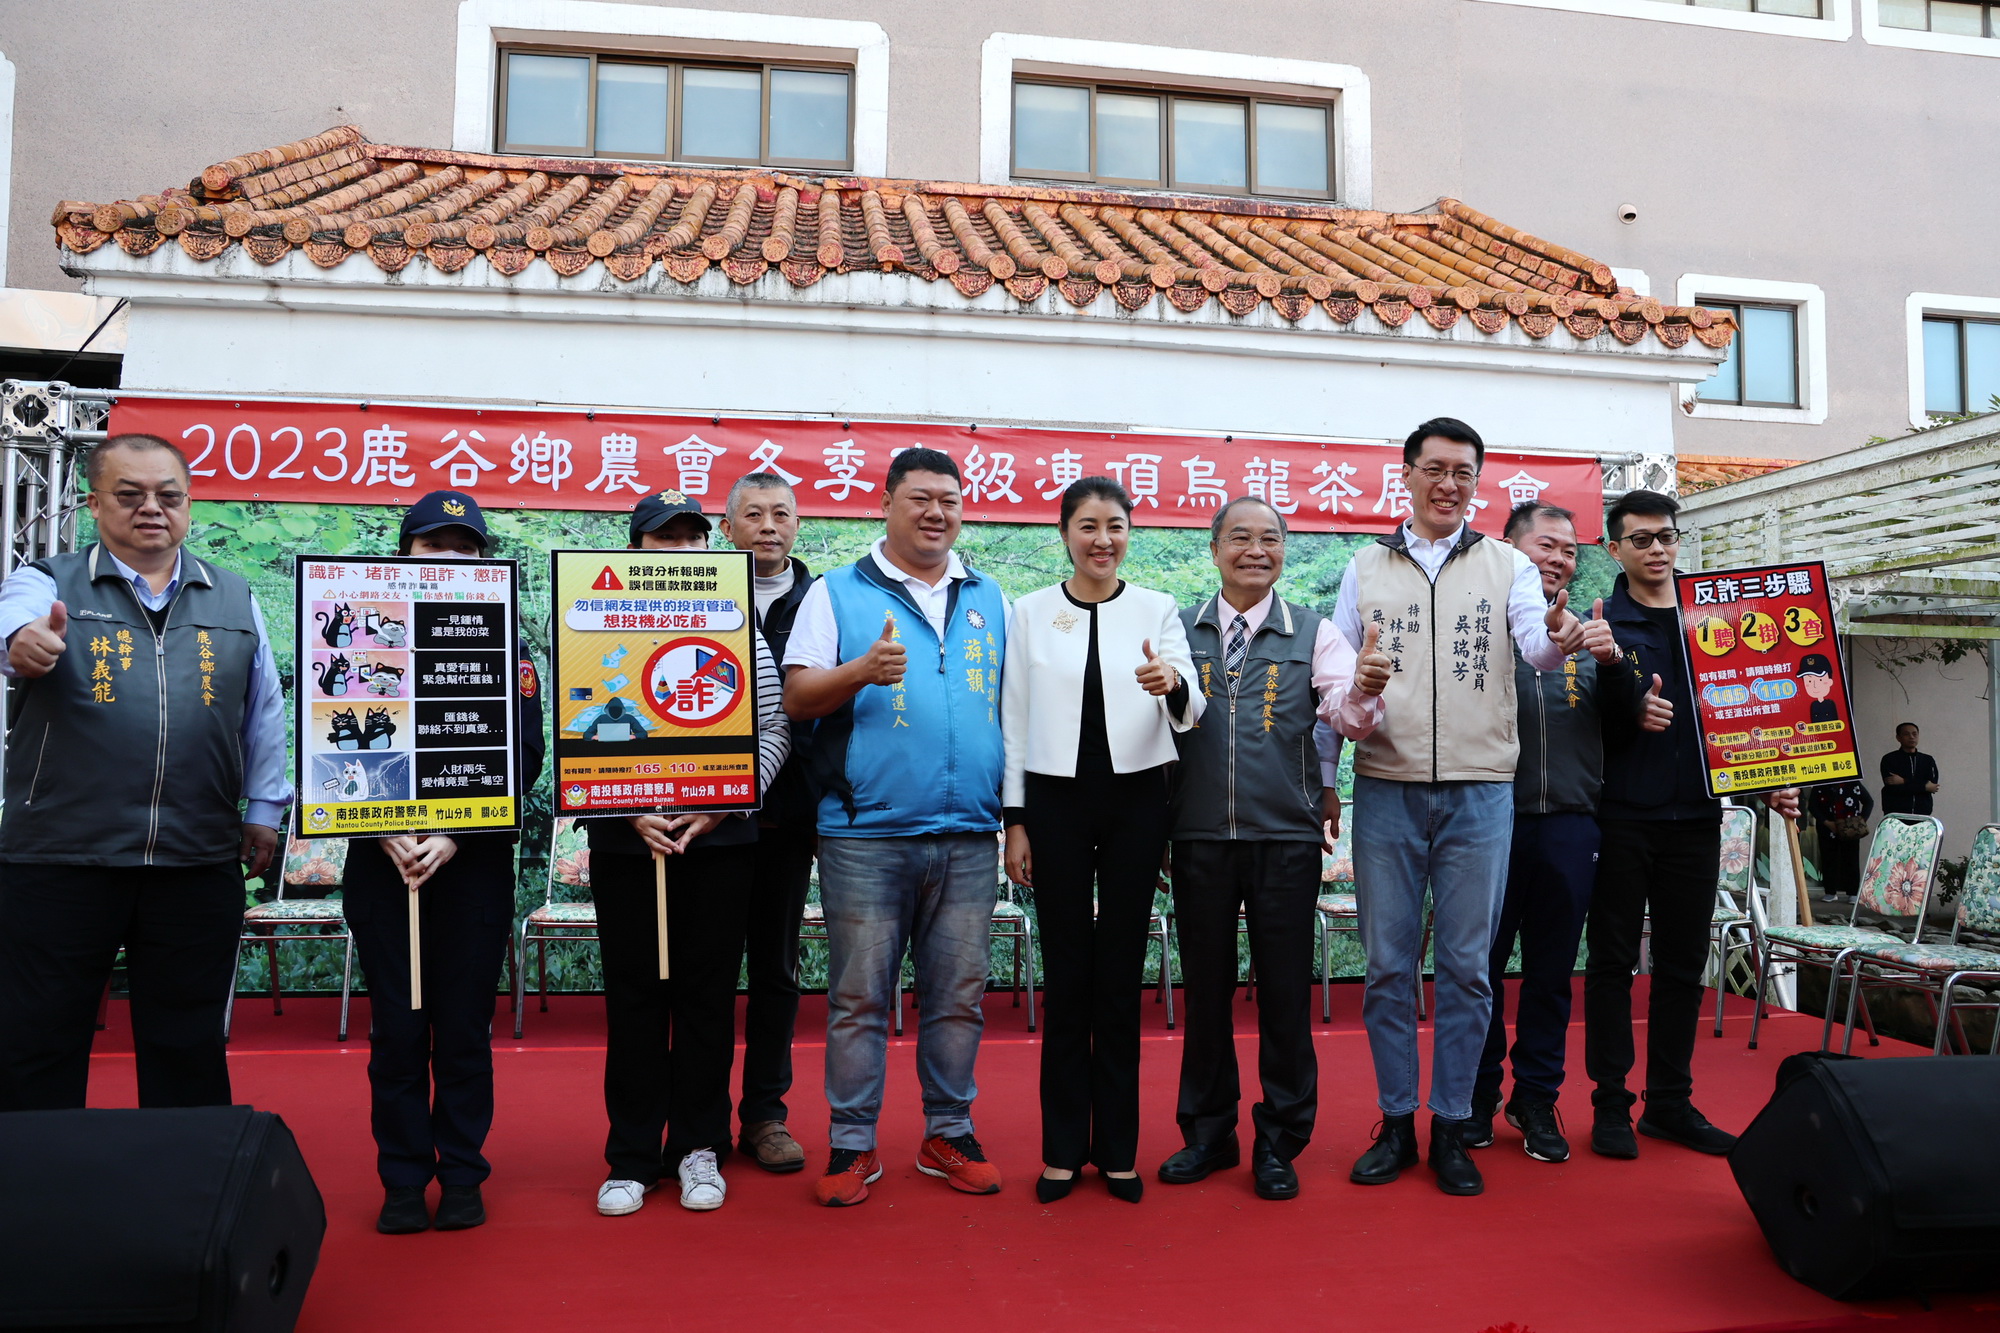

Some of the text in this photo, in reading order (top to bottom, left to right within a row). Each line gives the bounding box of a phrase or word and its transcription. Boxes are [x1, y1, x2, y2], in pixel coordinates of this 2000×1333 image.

[181, 423, 1551, 522] 2023鹿谷鄉農會冬季級凍頂烏龍茶展會
[628, 565, 718, 577] 投資分析報明牌
[387, 582, 439, 590] 感情詐騙篇
[628, 580, 718, 591] 誤信匯款散錢財
[1694, 570, 1812, 605] 反詐三步驟
[575, 599, 735, 612] 勿信網友提供的投資管道
[437, 615, 484, 625] 一見鍾情
[603, 614, 707, 629] 想投機必吃虧
[1407, 603, 1420, 633] 特助
[431, 626, 490, 637] 這是我的菜
[116, 629, 134, 671] 總幹事
[1388, 618, 1405, 673] 林晏生
[1453, 615, 1471, 682] 吳瑞芳
[1473, 598, 1492, 692] 南投縣議員
[90, 636, 115, 703] 林義能
[197, 630, 215, 706] 鹿谷鄉農會
[1201, 662, 1213, 698] 理事長
[676, 678, 715, 712] 詐
[1262, 664, 1280, 732] 鹿谷鄉農會
[1712, 682, 1793, 703] 165 110
[444, 711, 480, 722] 匯錢後
[439, 764, 487, 774] 人財兩失
[1733, 760, 1852, 781] 南投縣政府警察局 竹山分局 關心您
[421, 776, 504, 788] 愛情竟是一場空
[1751, 778, 1767, 786] County
[591, 783, 749, 798] 南投縣政府警察局 竹山分局 關心您
[612, 797, 634, 805] County
[336, 805, 508, 820] 南投縣政府警察局 竹山分局 關心您
[336, 821, 359, 829] Nantou
[360, 820, 383, 829] County
